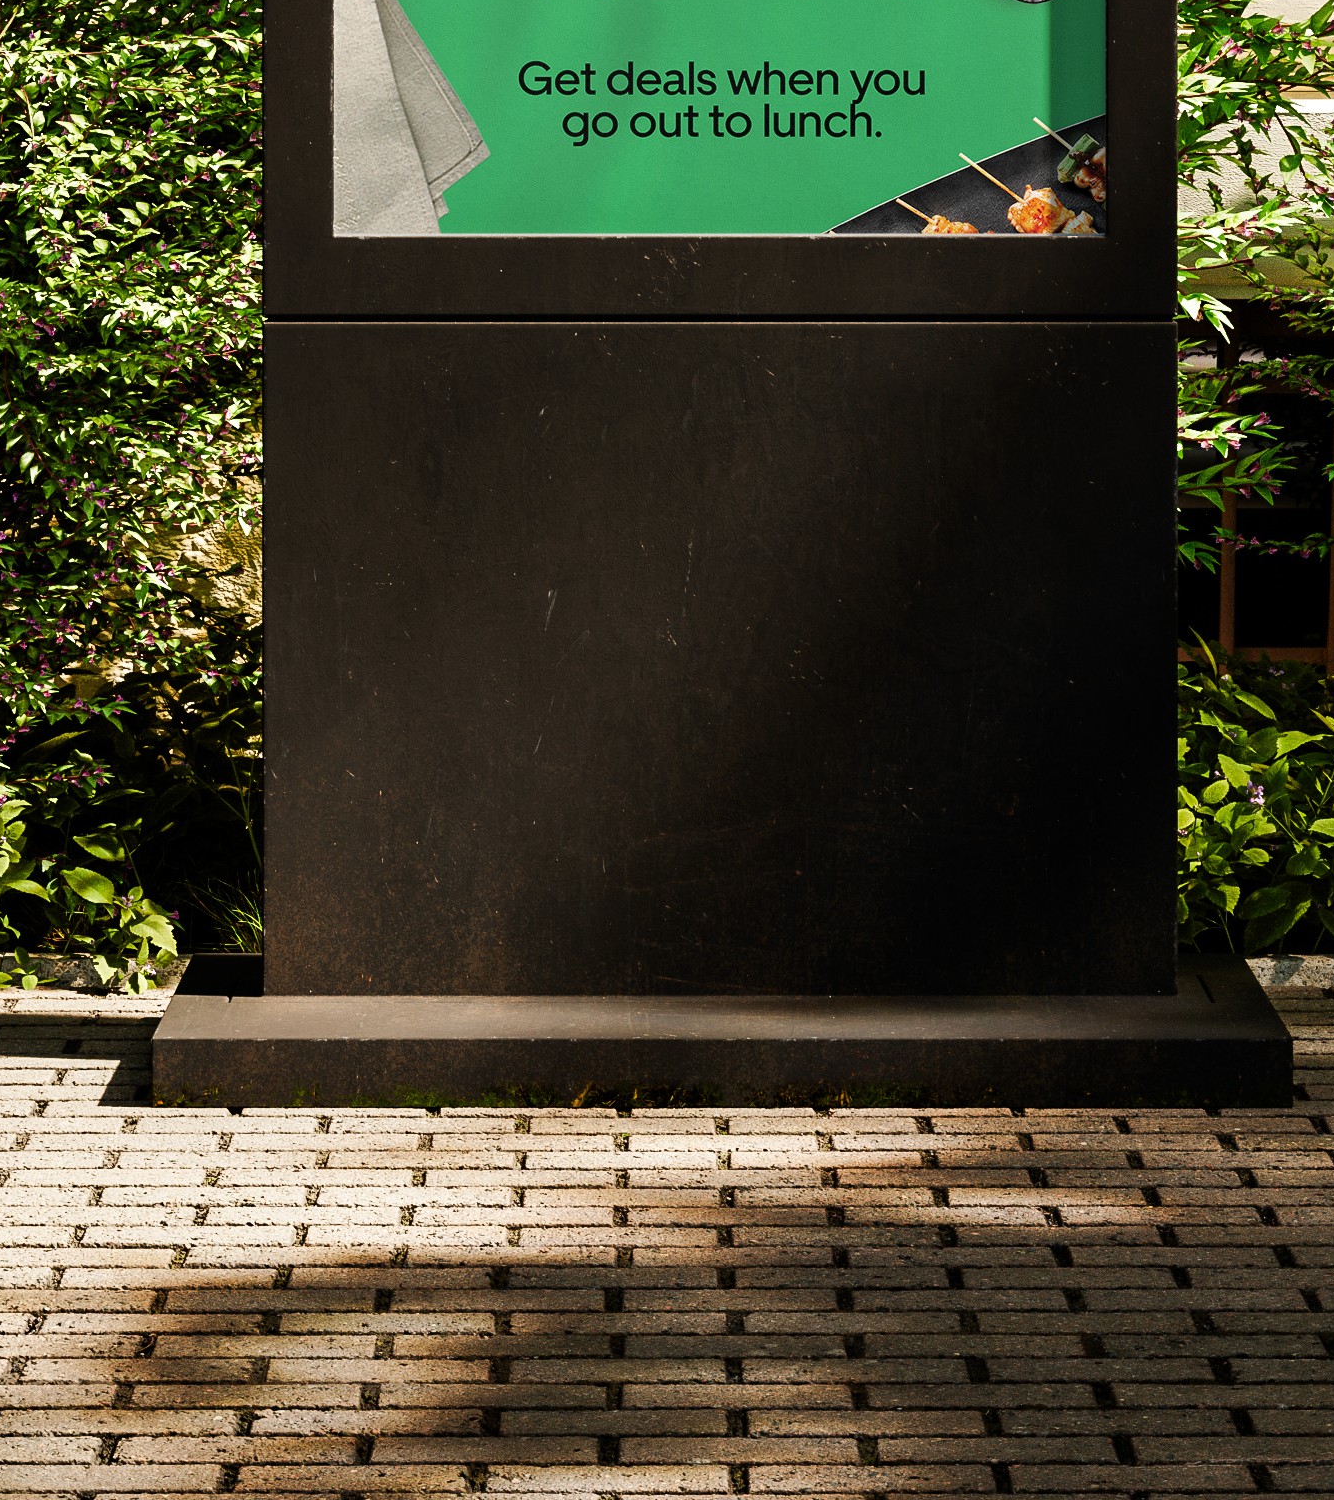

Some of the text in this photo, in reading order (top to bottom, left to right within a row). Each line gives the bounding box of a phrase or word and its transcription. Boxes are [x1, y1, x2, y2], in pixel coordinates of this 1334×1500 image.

[518, 60, 926, 105] Get deals when you
[562, 103, 882, 147] go out to lunch.
